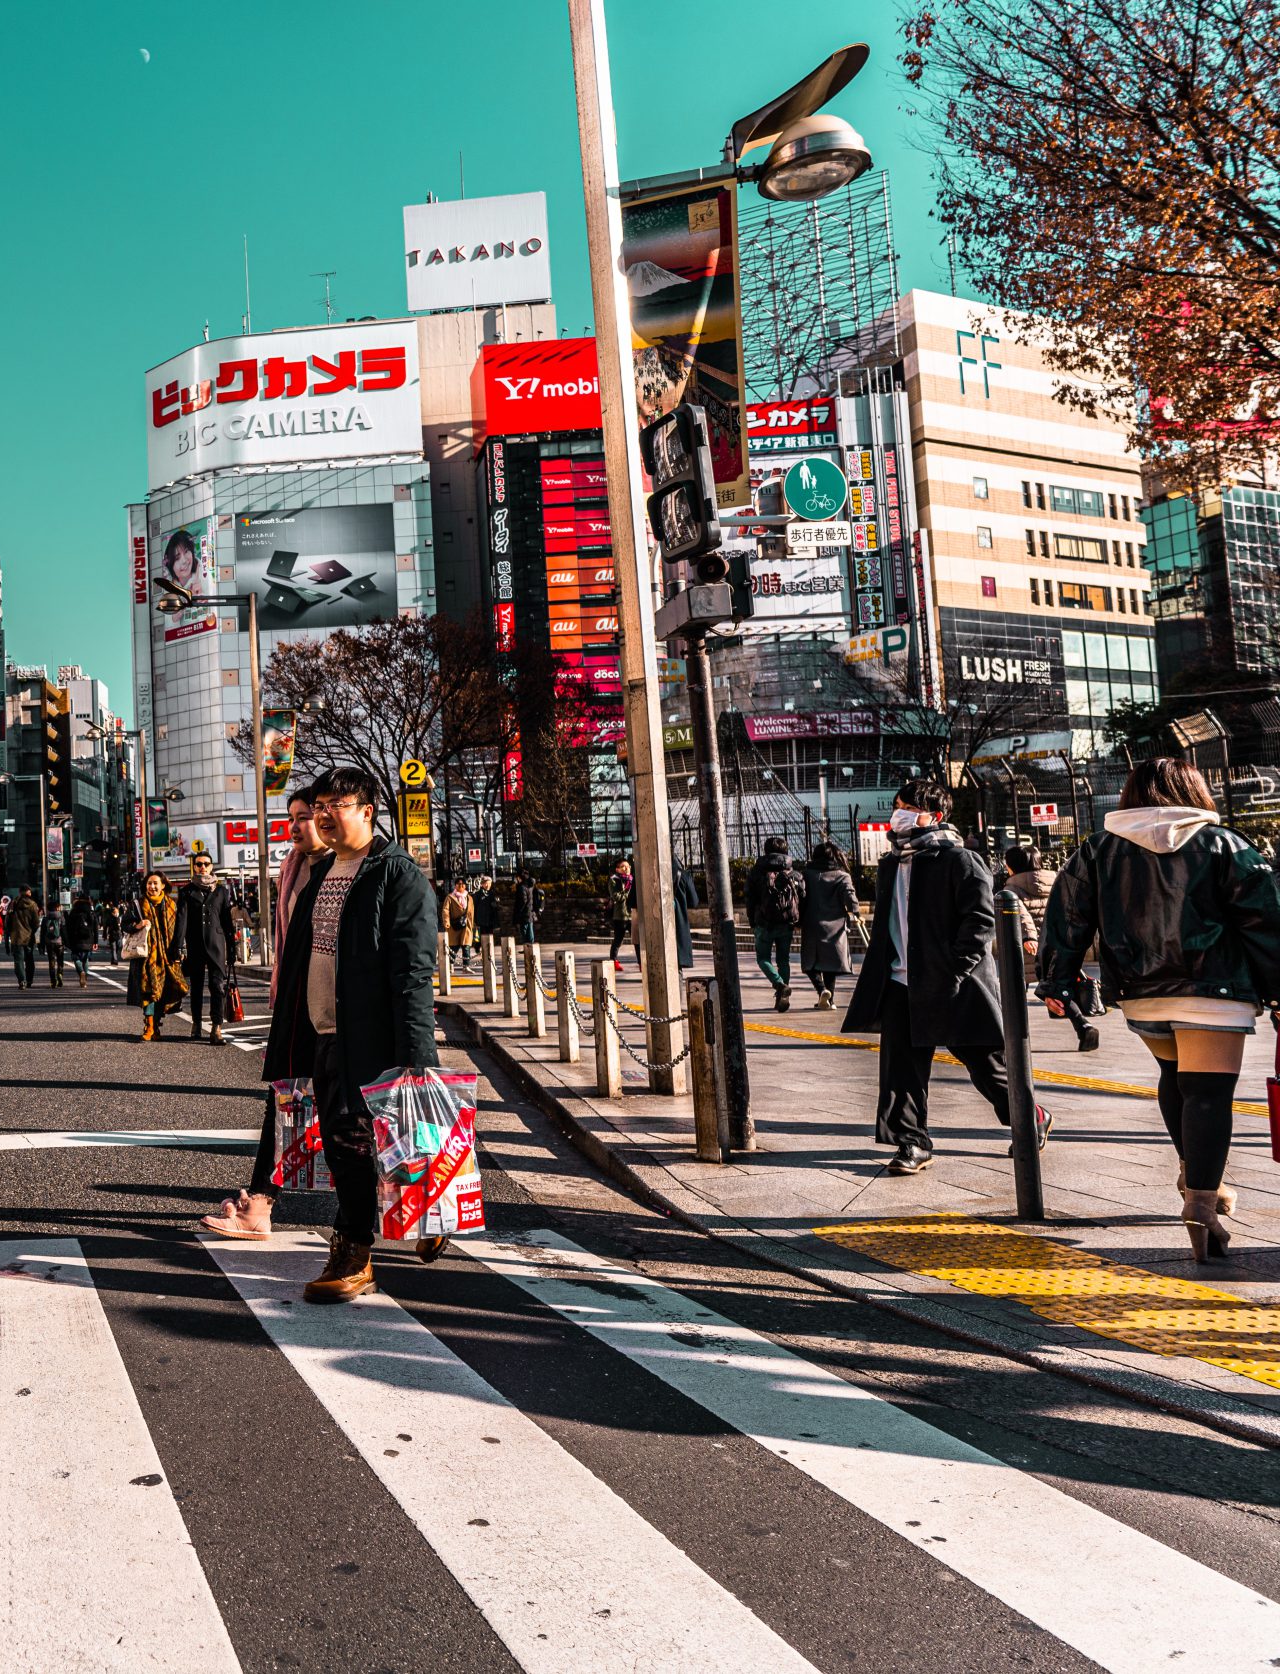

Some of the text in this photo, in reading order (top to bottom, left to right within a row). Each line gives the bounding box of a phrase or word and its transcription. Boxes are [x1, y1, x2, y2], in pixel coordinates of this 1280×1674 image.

[408, 237, 542, 266] TAKANO
[152, 347, 406, 428] ビックカメラ
[176, 404, 373, 457] BIC CAMERA
[790, 528, 848, 541] 歩行者優先
[550, 573, 575, 583] au
[553, 621, 577, 632] au
[882, 627, 907, 668] P
[960, 656, 1051, 682] LUSH FRESH
[754, 717, 798, 726] Welcome
[406, 763, 420, 780] 2
[460, 1199, 481, 1211] ビック
[462, 1210, 482, 1222] カメラ
